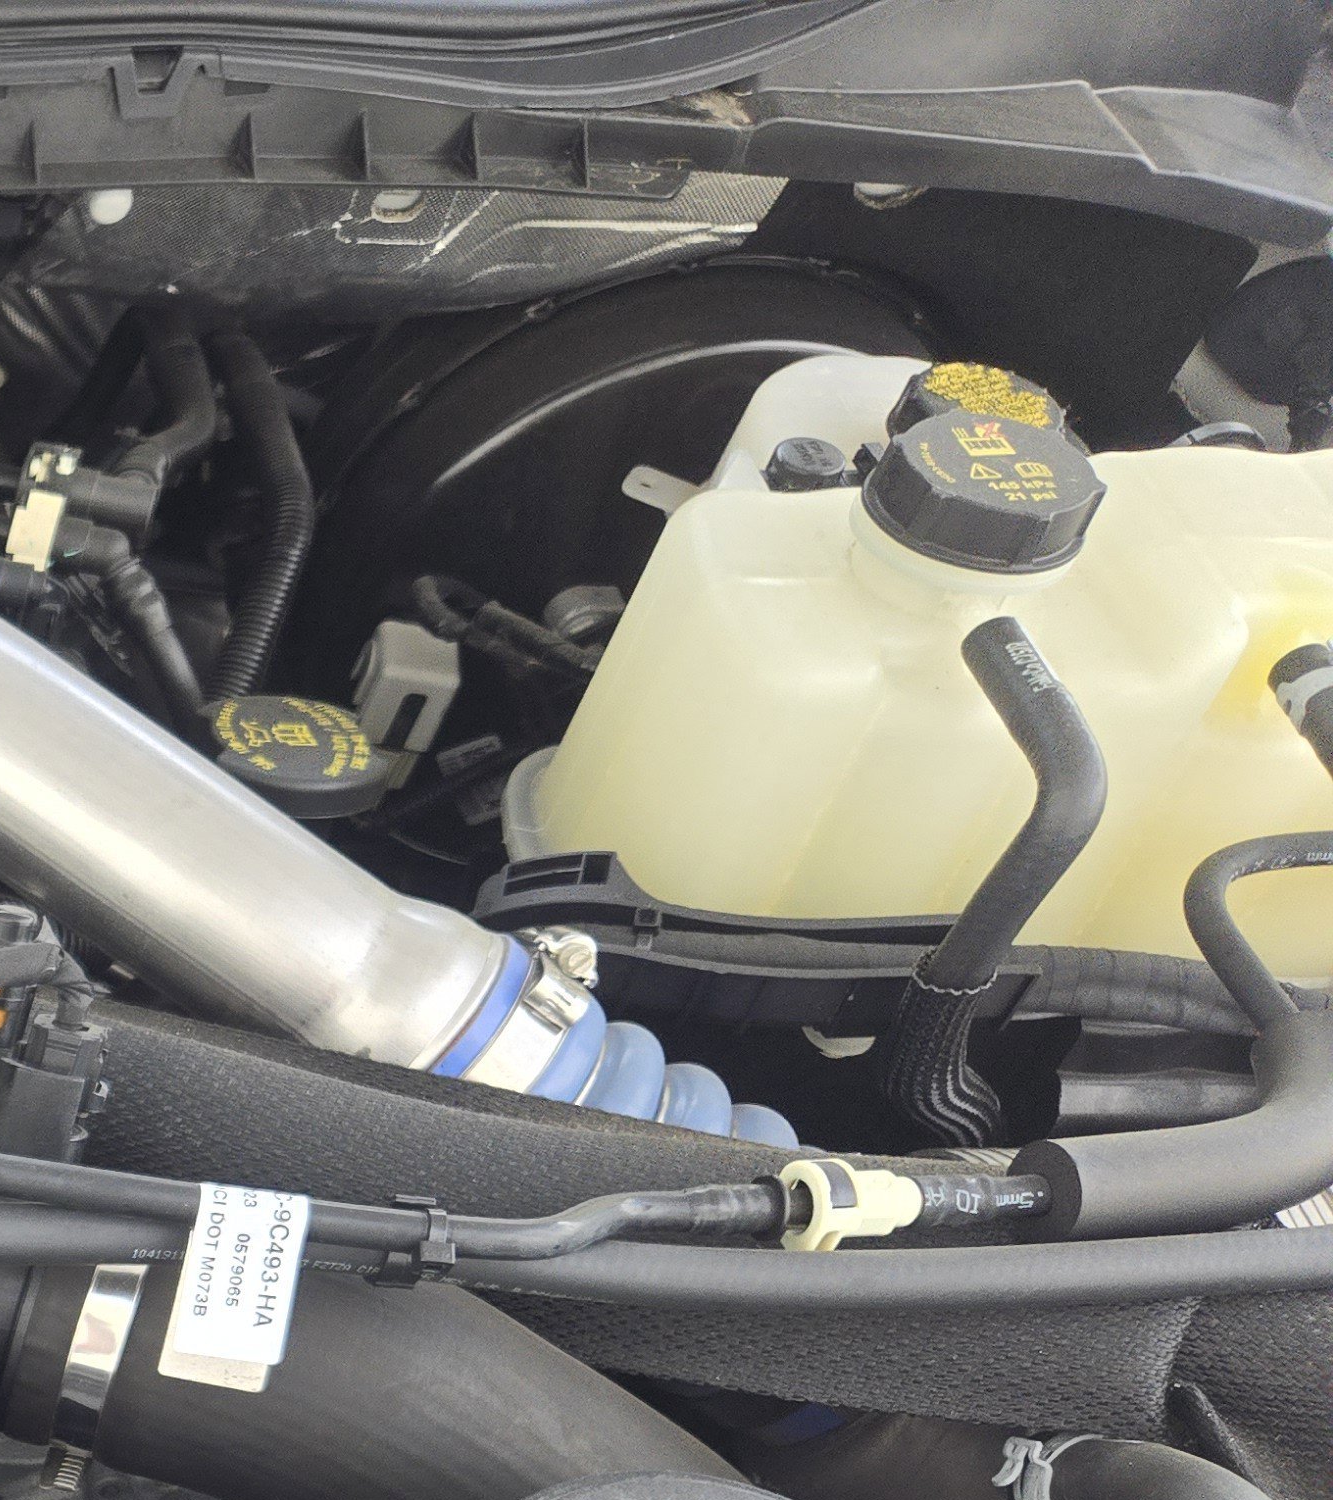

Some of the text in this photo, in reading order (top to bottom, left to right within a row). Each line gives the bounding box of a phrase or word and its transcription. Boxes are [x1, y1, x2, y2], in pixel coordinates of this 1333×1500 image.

[193, 1187, 228, 1317] CI DOT M073B
[225, 1233, 251, 1307] 0579065
